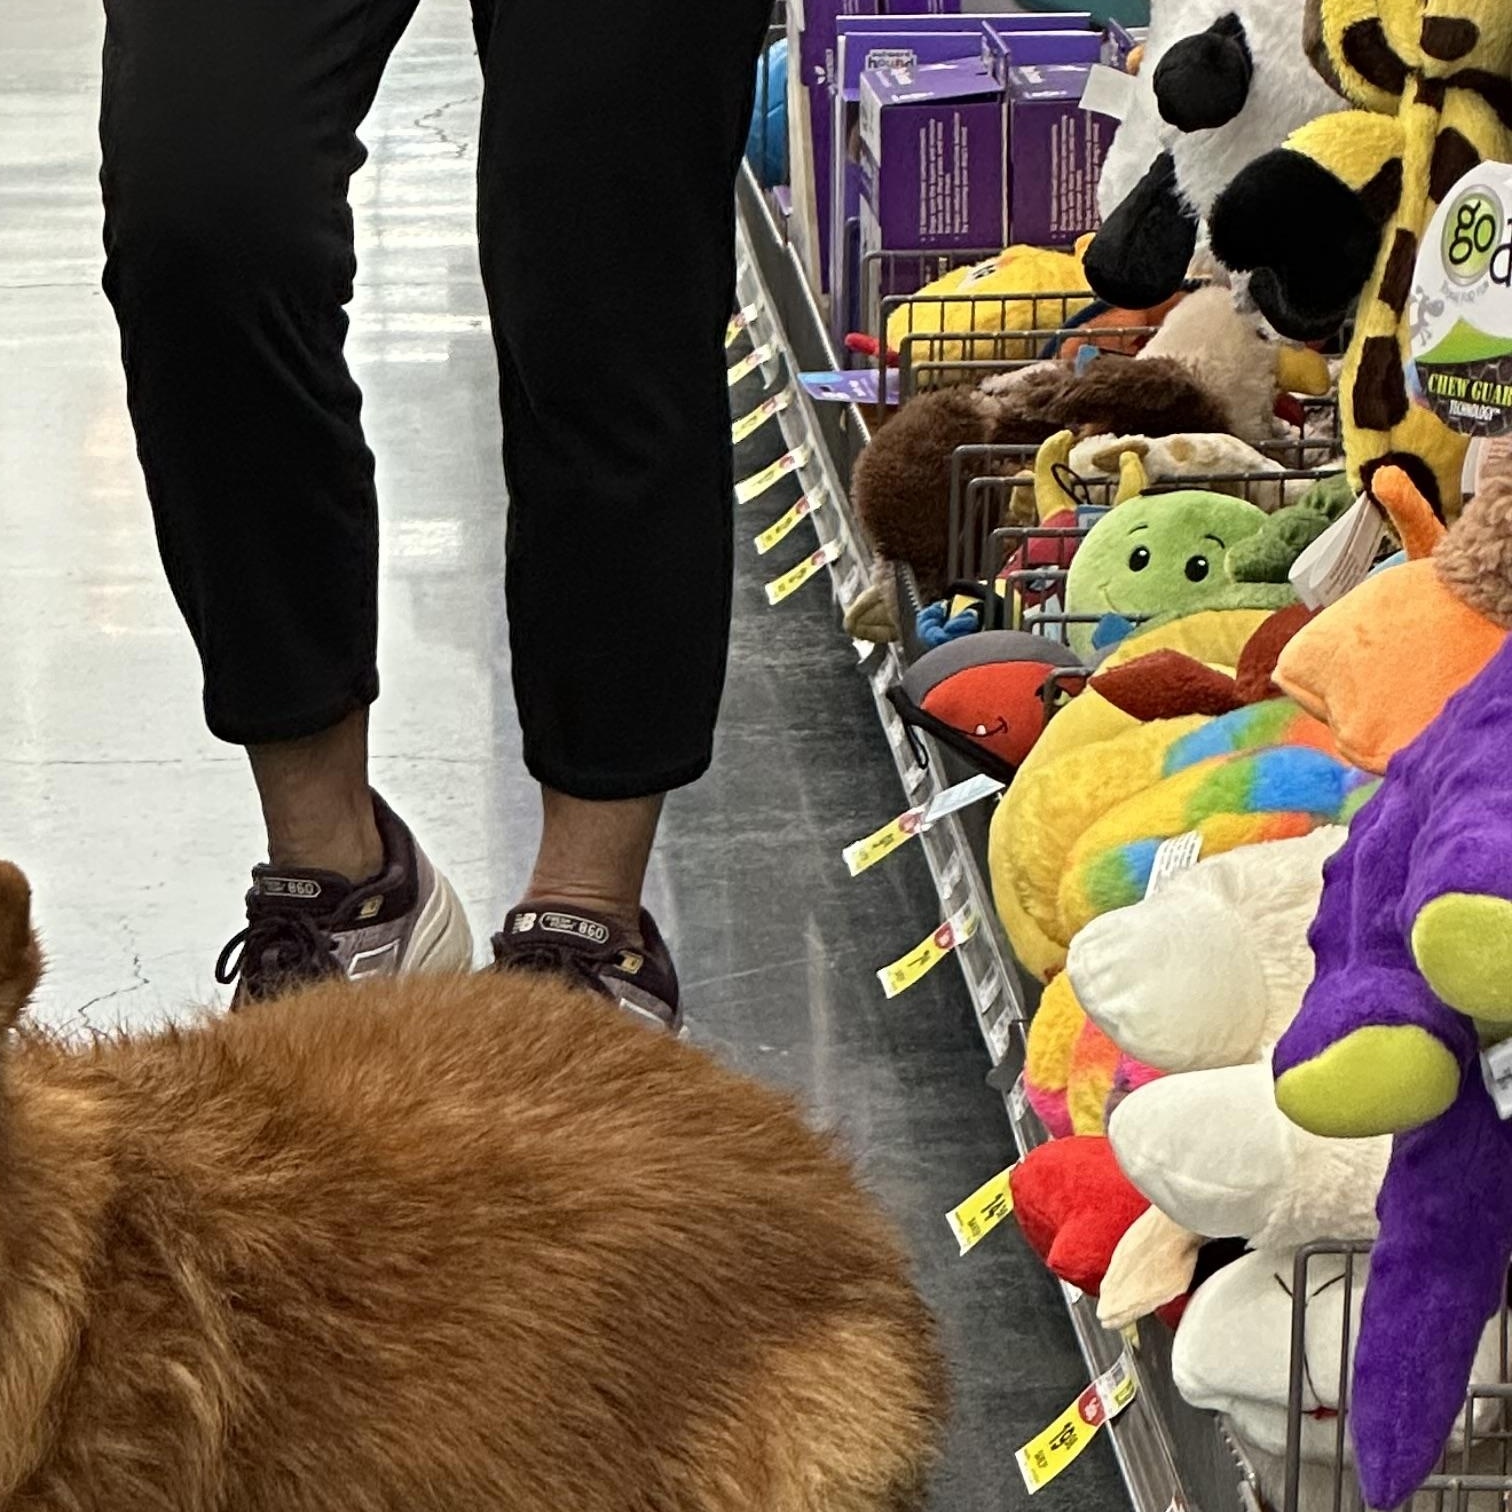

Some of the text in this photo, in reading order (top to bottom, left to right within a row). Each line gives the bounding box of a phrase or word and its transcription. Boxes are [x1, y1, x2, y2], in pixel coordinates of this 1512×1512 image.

[1449, 200, 1496, 265] go
[1428, 373, 1470, 398] CHEW
[578, 921, 604, 939] 860
